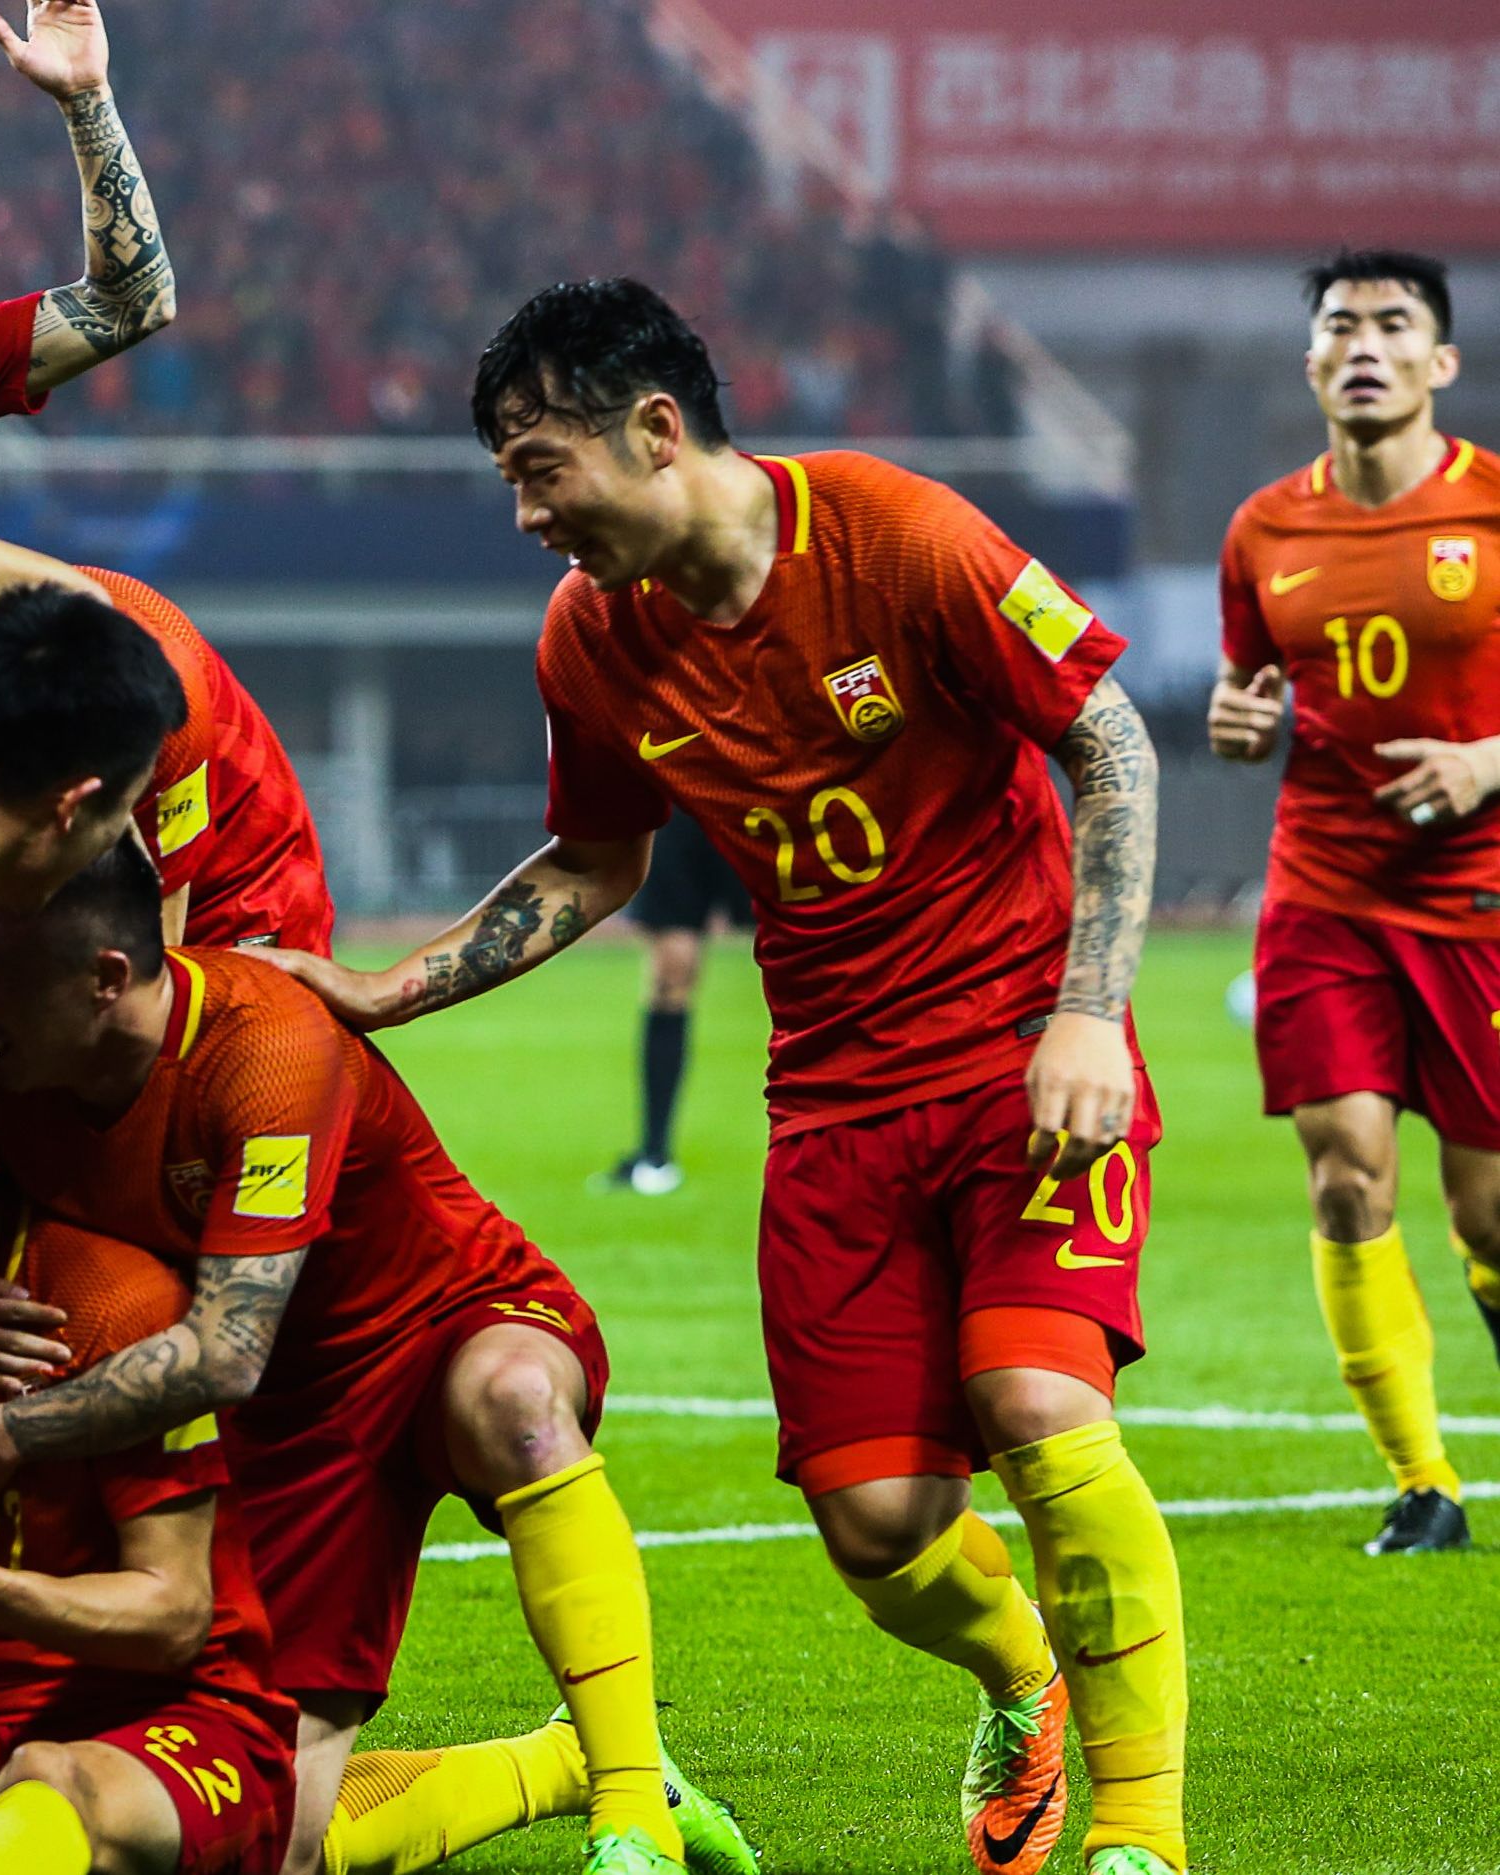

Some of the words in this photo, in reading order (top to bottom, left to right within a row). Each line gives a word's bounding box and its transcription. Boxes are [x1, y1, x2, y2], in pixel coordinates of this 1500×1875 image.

[831, 662, 880, 696] CFA
[1324, 614, 1409, 700] 10
[744, 786, 887, 902] 20
[1020, 1127, 1138, 1245] 20
